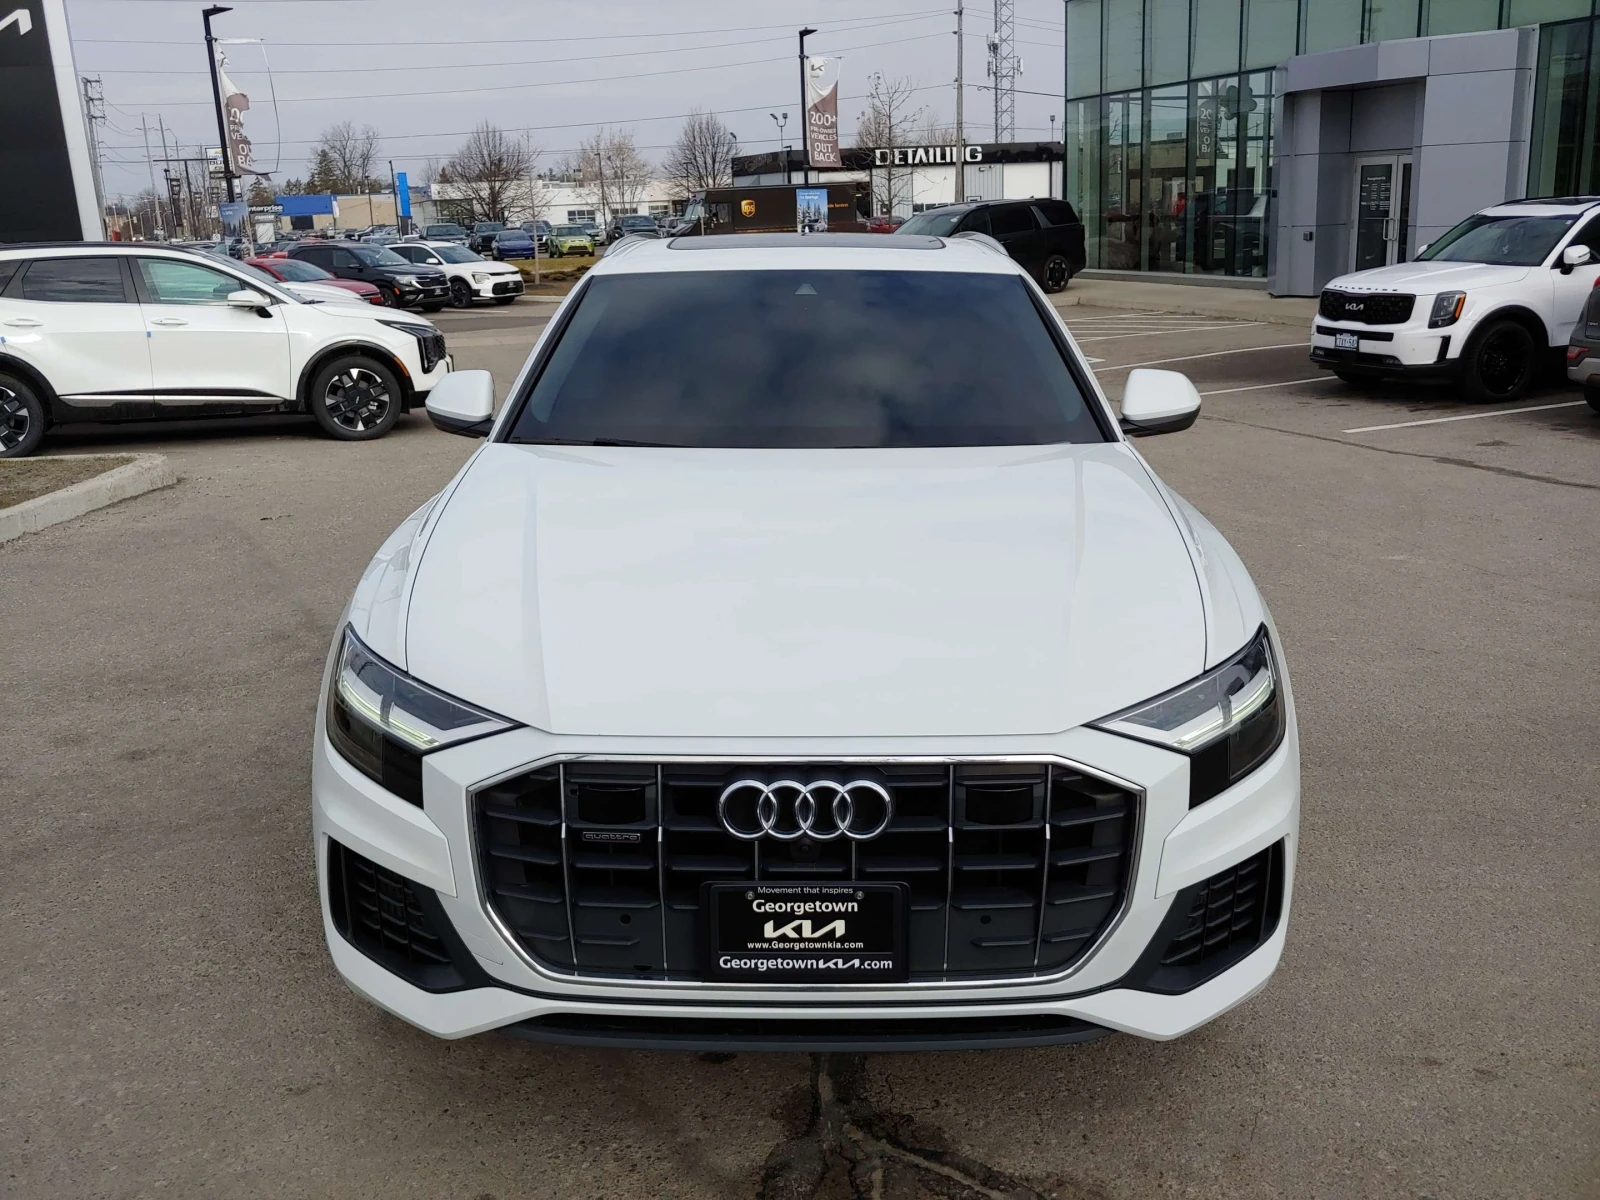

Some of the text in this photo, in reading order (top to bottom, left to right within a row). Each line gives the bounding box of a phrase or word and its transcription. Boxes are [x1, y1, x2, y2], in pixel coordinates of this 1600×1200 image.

[810, 111, 837, 126] 200+
[811, 132, 838, 141] VEHICLES
[815, 142, 833, 153] OUT
[814, 151, 837, 162] BACK
[874, 146, 983, 166] DETAILING
[1345, 303, 1364, 311] KIA
[757, 886, 801, 894] Movement
[822, 886, 854, 895] inspires
[752, 899, 858, 915] Georgetown
[763, 919, 846, 939] KIA
[747, 940, 864, 950] www.Georgetownkia.com
